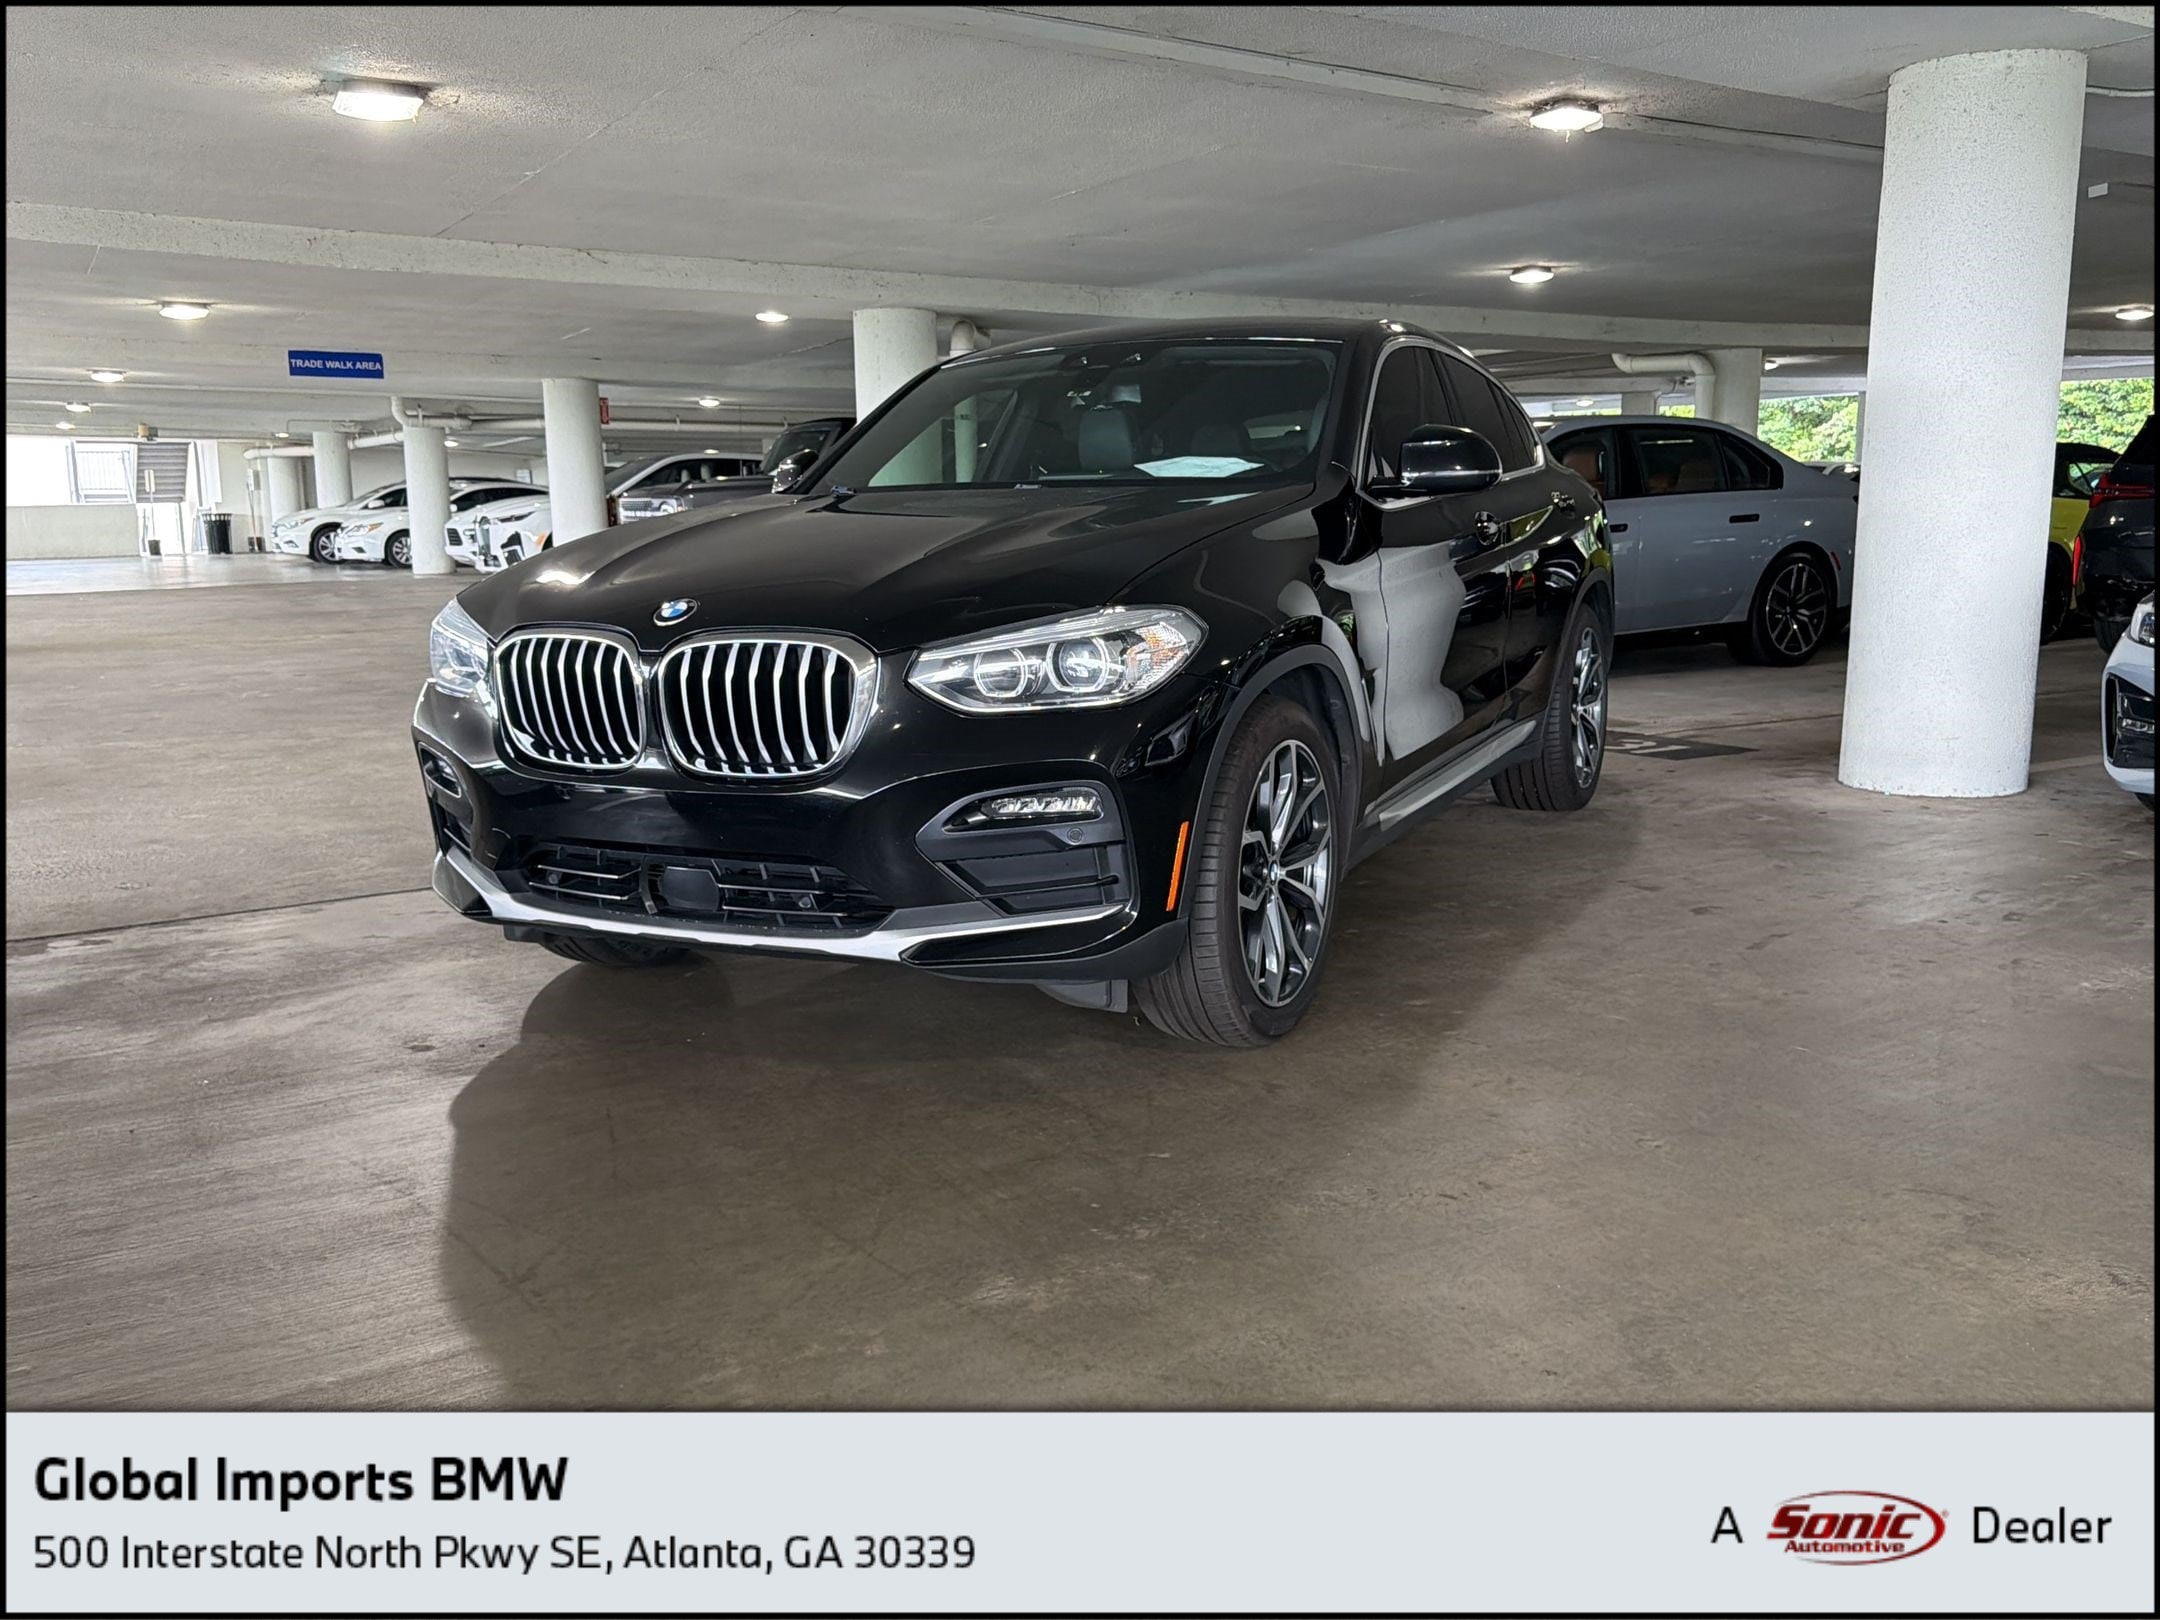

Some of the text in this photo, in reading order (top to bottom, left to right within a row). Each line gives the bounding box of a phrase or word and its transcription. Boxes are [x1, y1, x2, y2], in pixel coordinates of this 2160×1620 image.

[290, 359, 382, 371] TRADE WALK AREA
